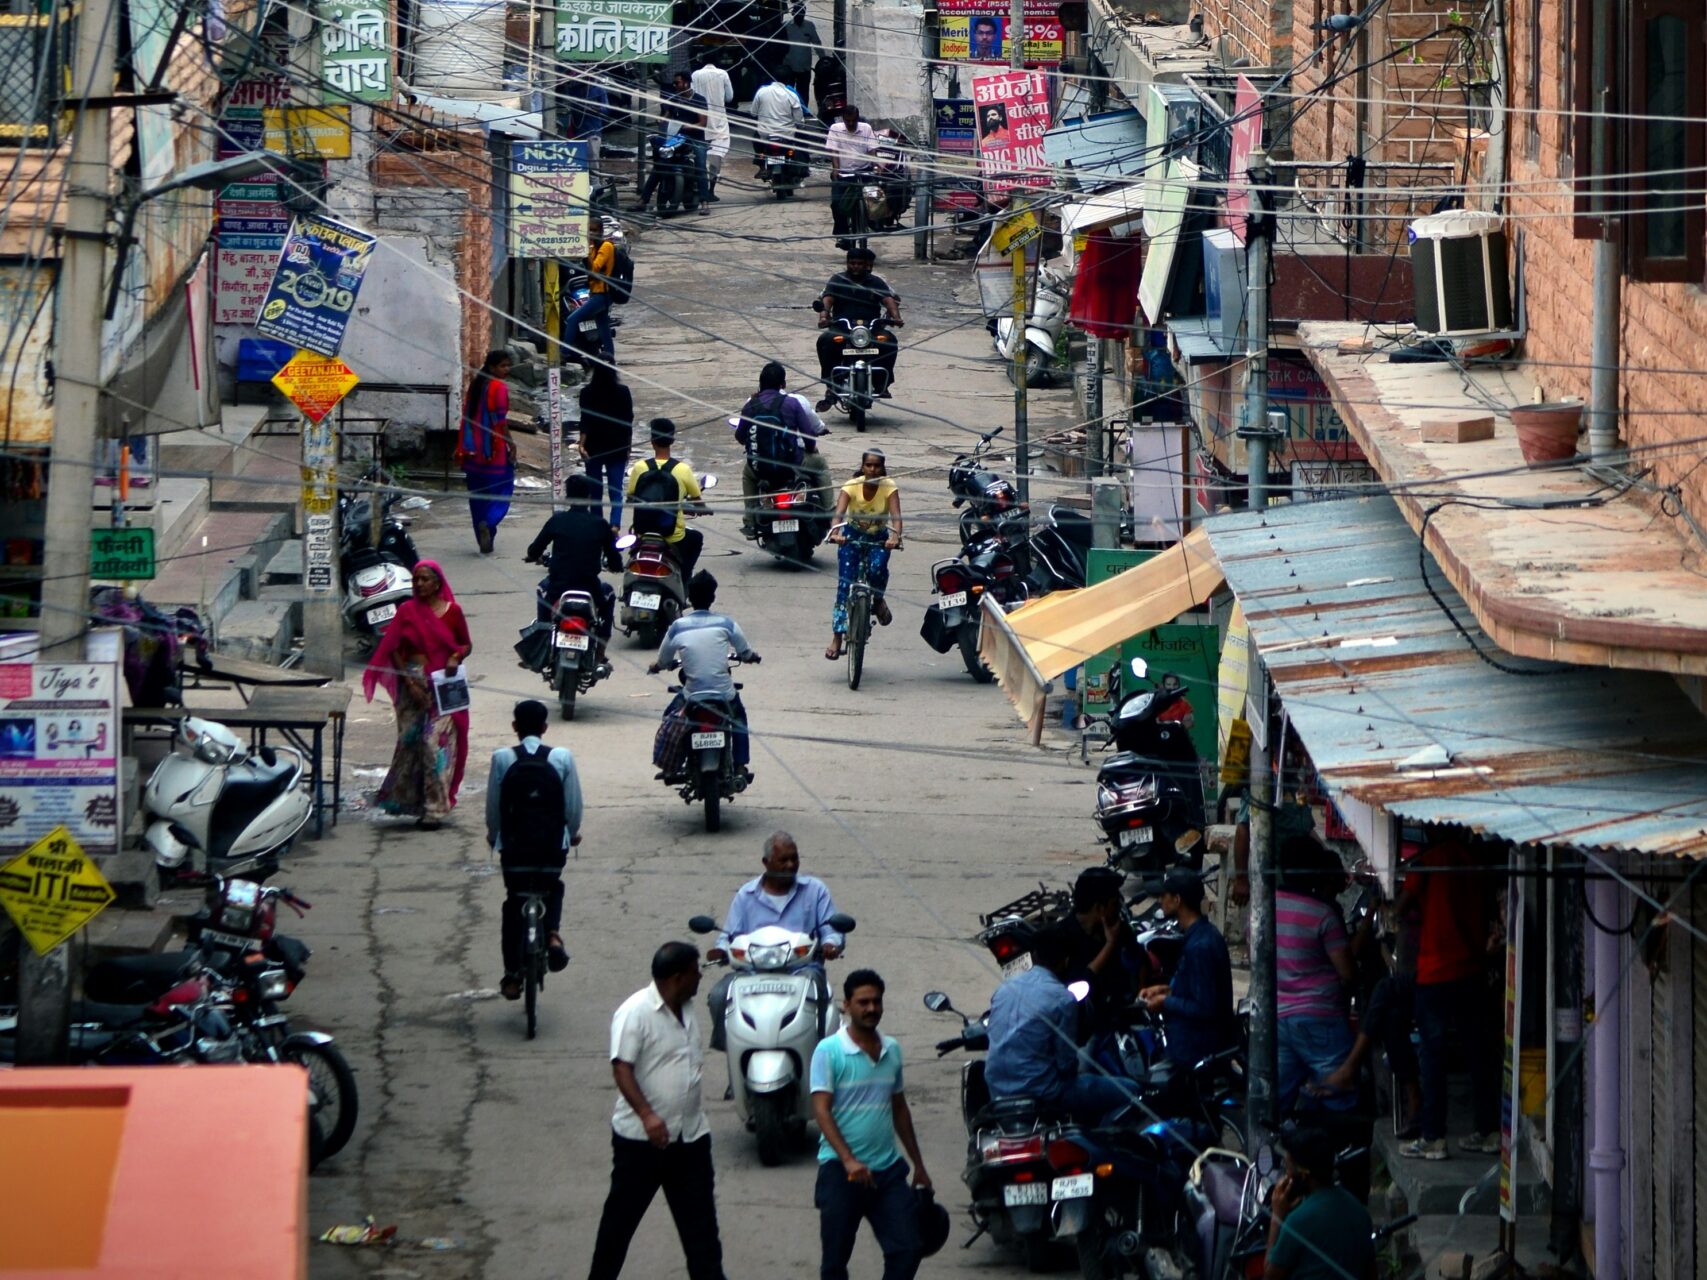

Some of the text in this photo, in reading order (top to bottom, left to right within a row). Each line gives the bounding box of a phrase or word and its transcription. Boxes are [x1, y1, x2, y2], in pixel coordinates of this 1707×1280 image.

[939, 8, 996, 17] Accountancy
[942, 27, 969, 37] Merit
[624, 25, 670, 55] चाय
[942, 43, 968, 55] Jodhpur
[323, 58, 388, 93] चाय
[524, 143, 578, 164] Nicky
[295, 243, 309, 254] DJ
[287, 365, 345, 377] GEETANJALI
[33, 871, 69, 901] ITI
